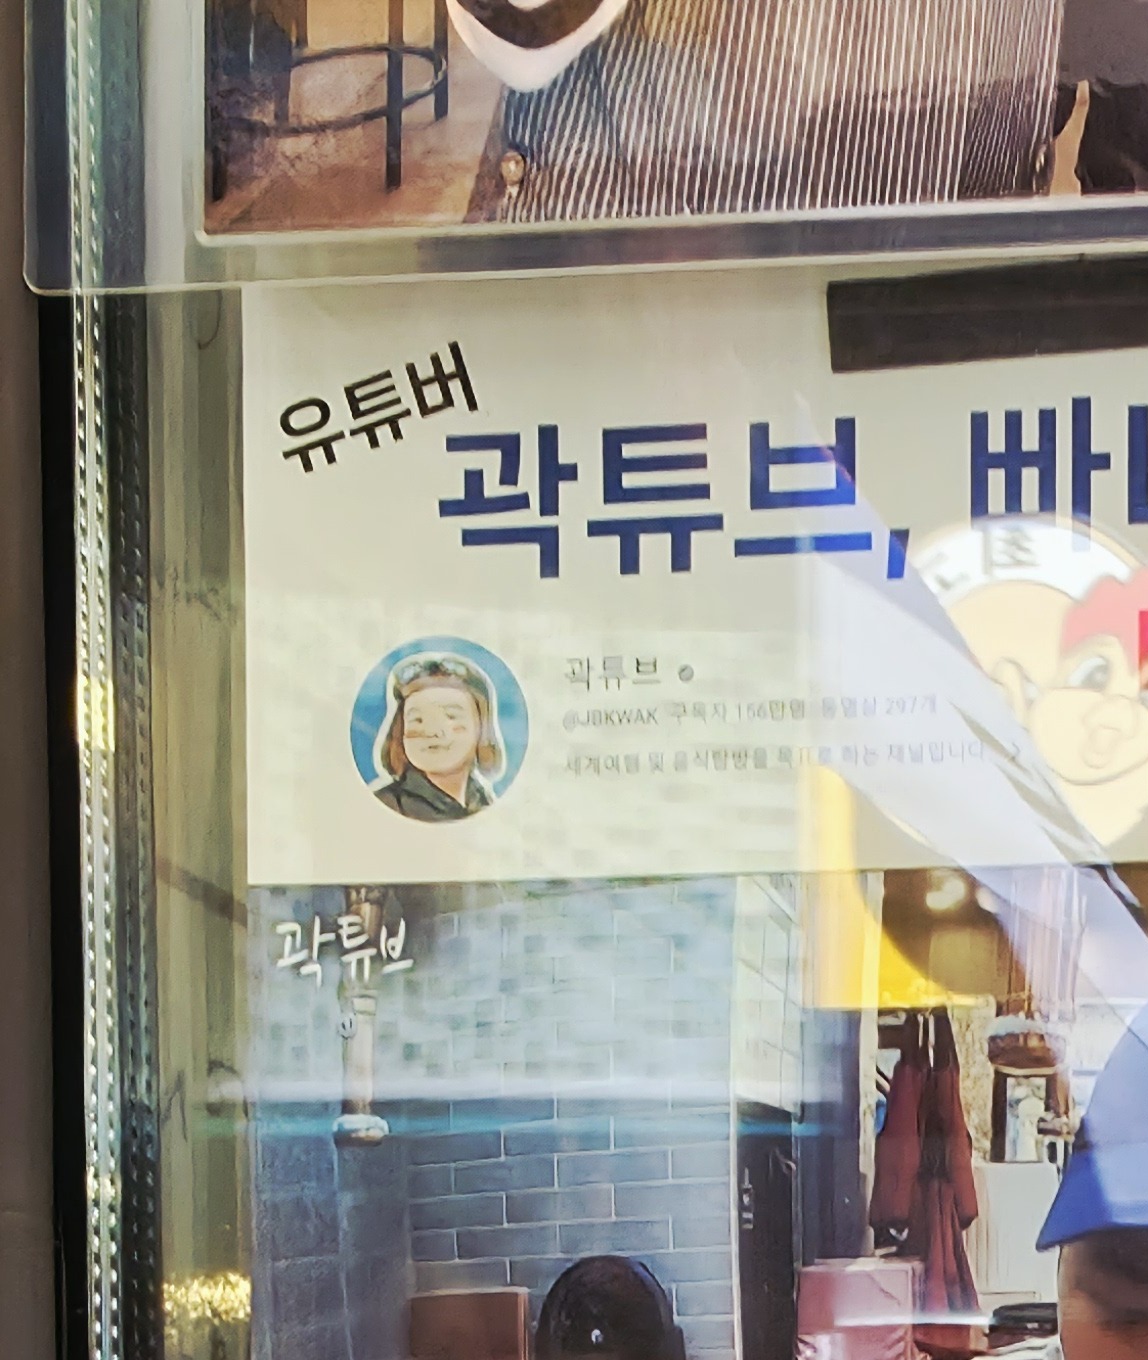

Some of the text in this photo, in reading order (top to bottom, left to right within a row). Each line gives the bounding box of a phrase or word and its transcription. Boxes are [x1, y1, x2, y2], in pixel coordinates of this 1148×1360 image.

[280, 341, 479, 473] 유튜버
[438, 416, 911, 580] 곽튜브,
[565, 655, 662, 691] 곽튜브
[275, 914, 413, 988] 곽튜브
